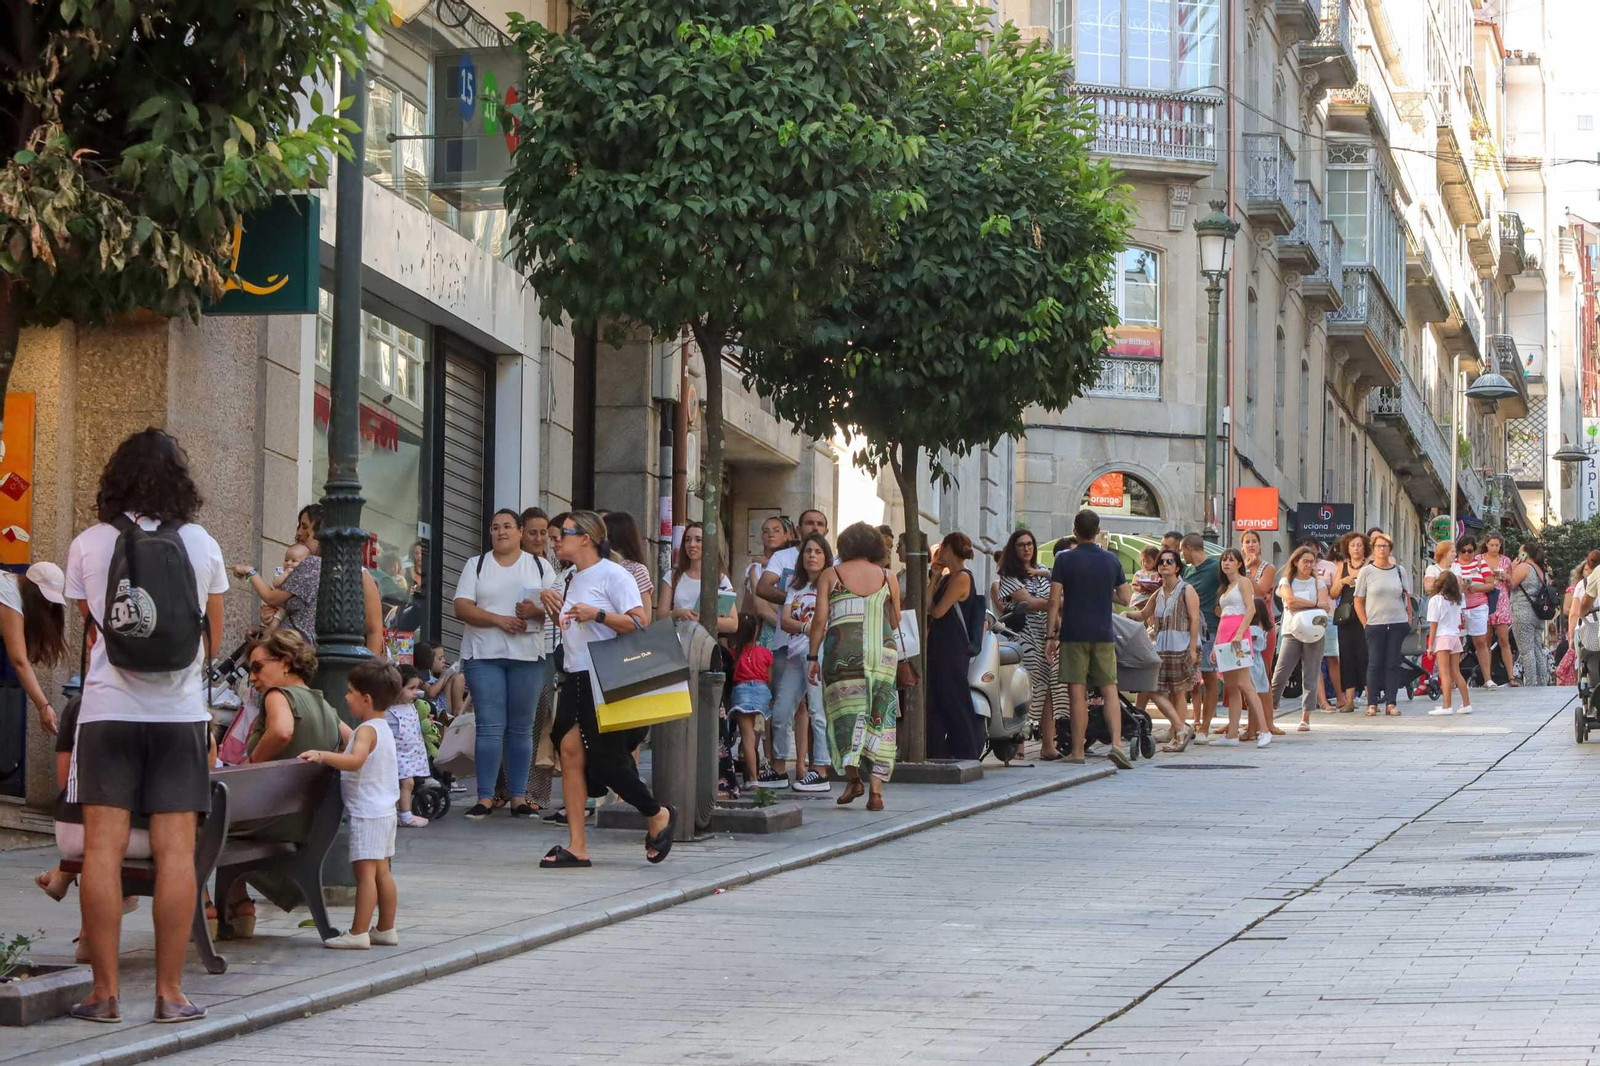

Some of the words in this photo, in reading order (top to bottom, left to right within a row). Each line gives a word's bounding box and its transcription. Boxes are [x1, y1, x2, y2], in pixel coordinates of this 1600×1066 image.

[460, 68, 473, 105] 15
[1090, 496, 1120, 506] orange
[1236, 518, 1273, 529] orange
